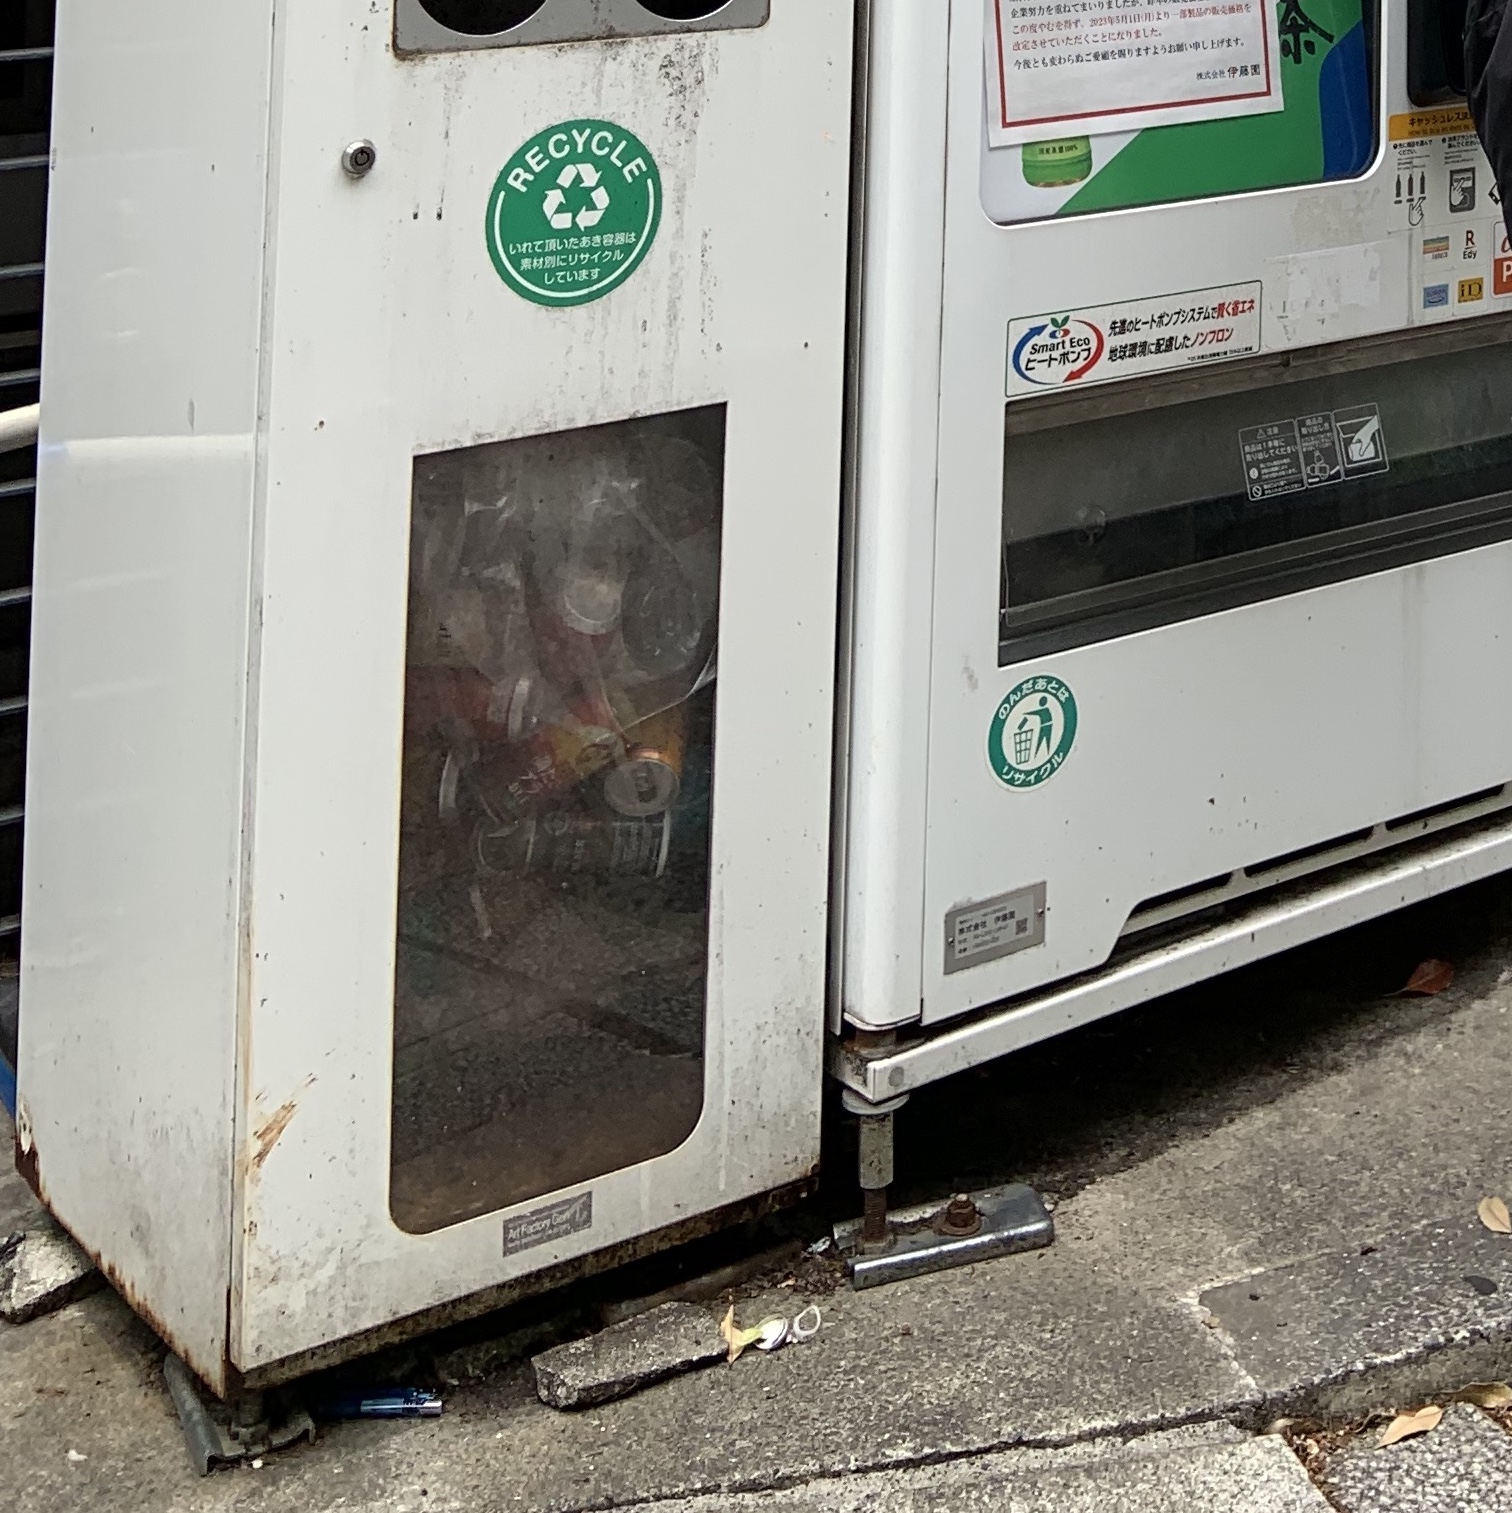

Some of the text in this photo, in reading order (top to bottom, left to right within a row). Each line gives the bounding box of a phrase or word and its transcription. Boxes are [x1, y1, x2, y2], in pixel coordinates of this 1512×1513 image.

[507, 128, 648, 193] RECYCLE
[509, 232, 636, 255] いれて頂いたあき容器は
[1466, 230, 1475, 246] R
[520, 249, 624, 271] 素材別にリサイクル
[1463, 249, 1477, 260] Edy
[544, 268, 601, 285] しています
[1029, 337, 1091, 355] Smart Eco
[1107, 328, 1234, 363] 地球環境に配慮したノンフロン
[1025, 348, 1091, 372] ヒートポンプ
[999, 678, 1069, 720] のんだあとは
[1002, 752, 1063, 785] リサイクル
